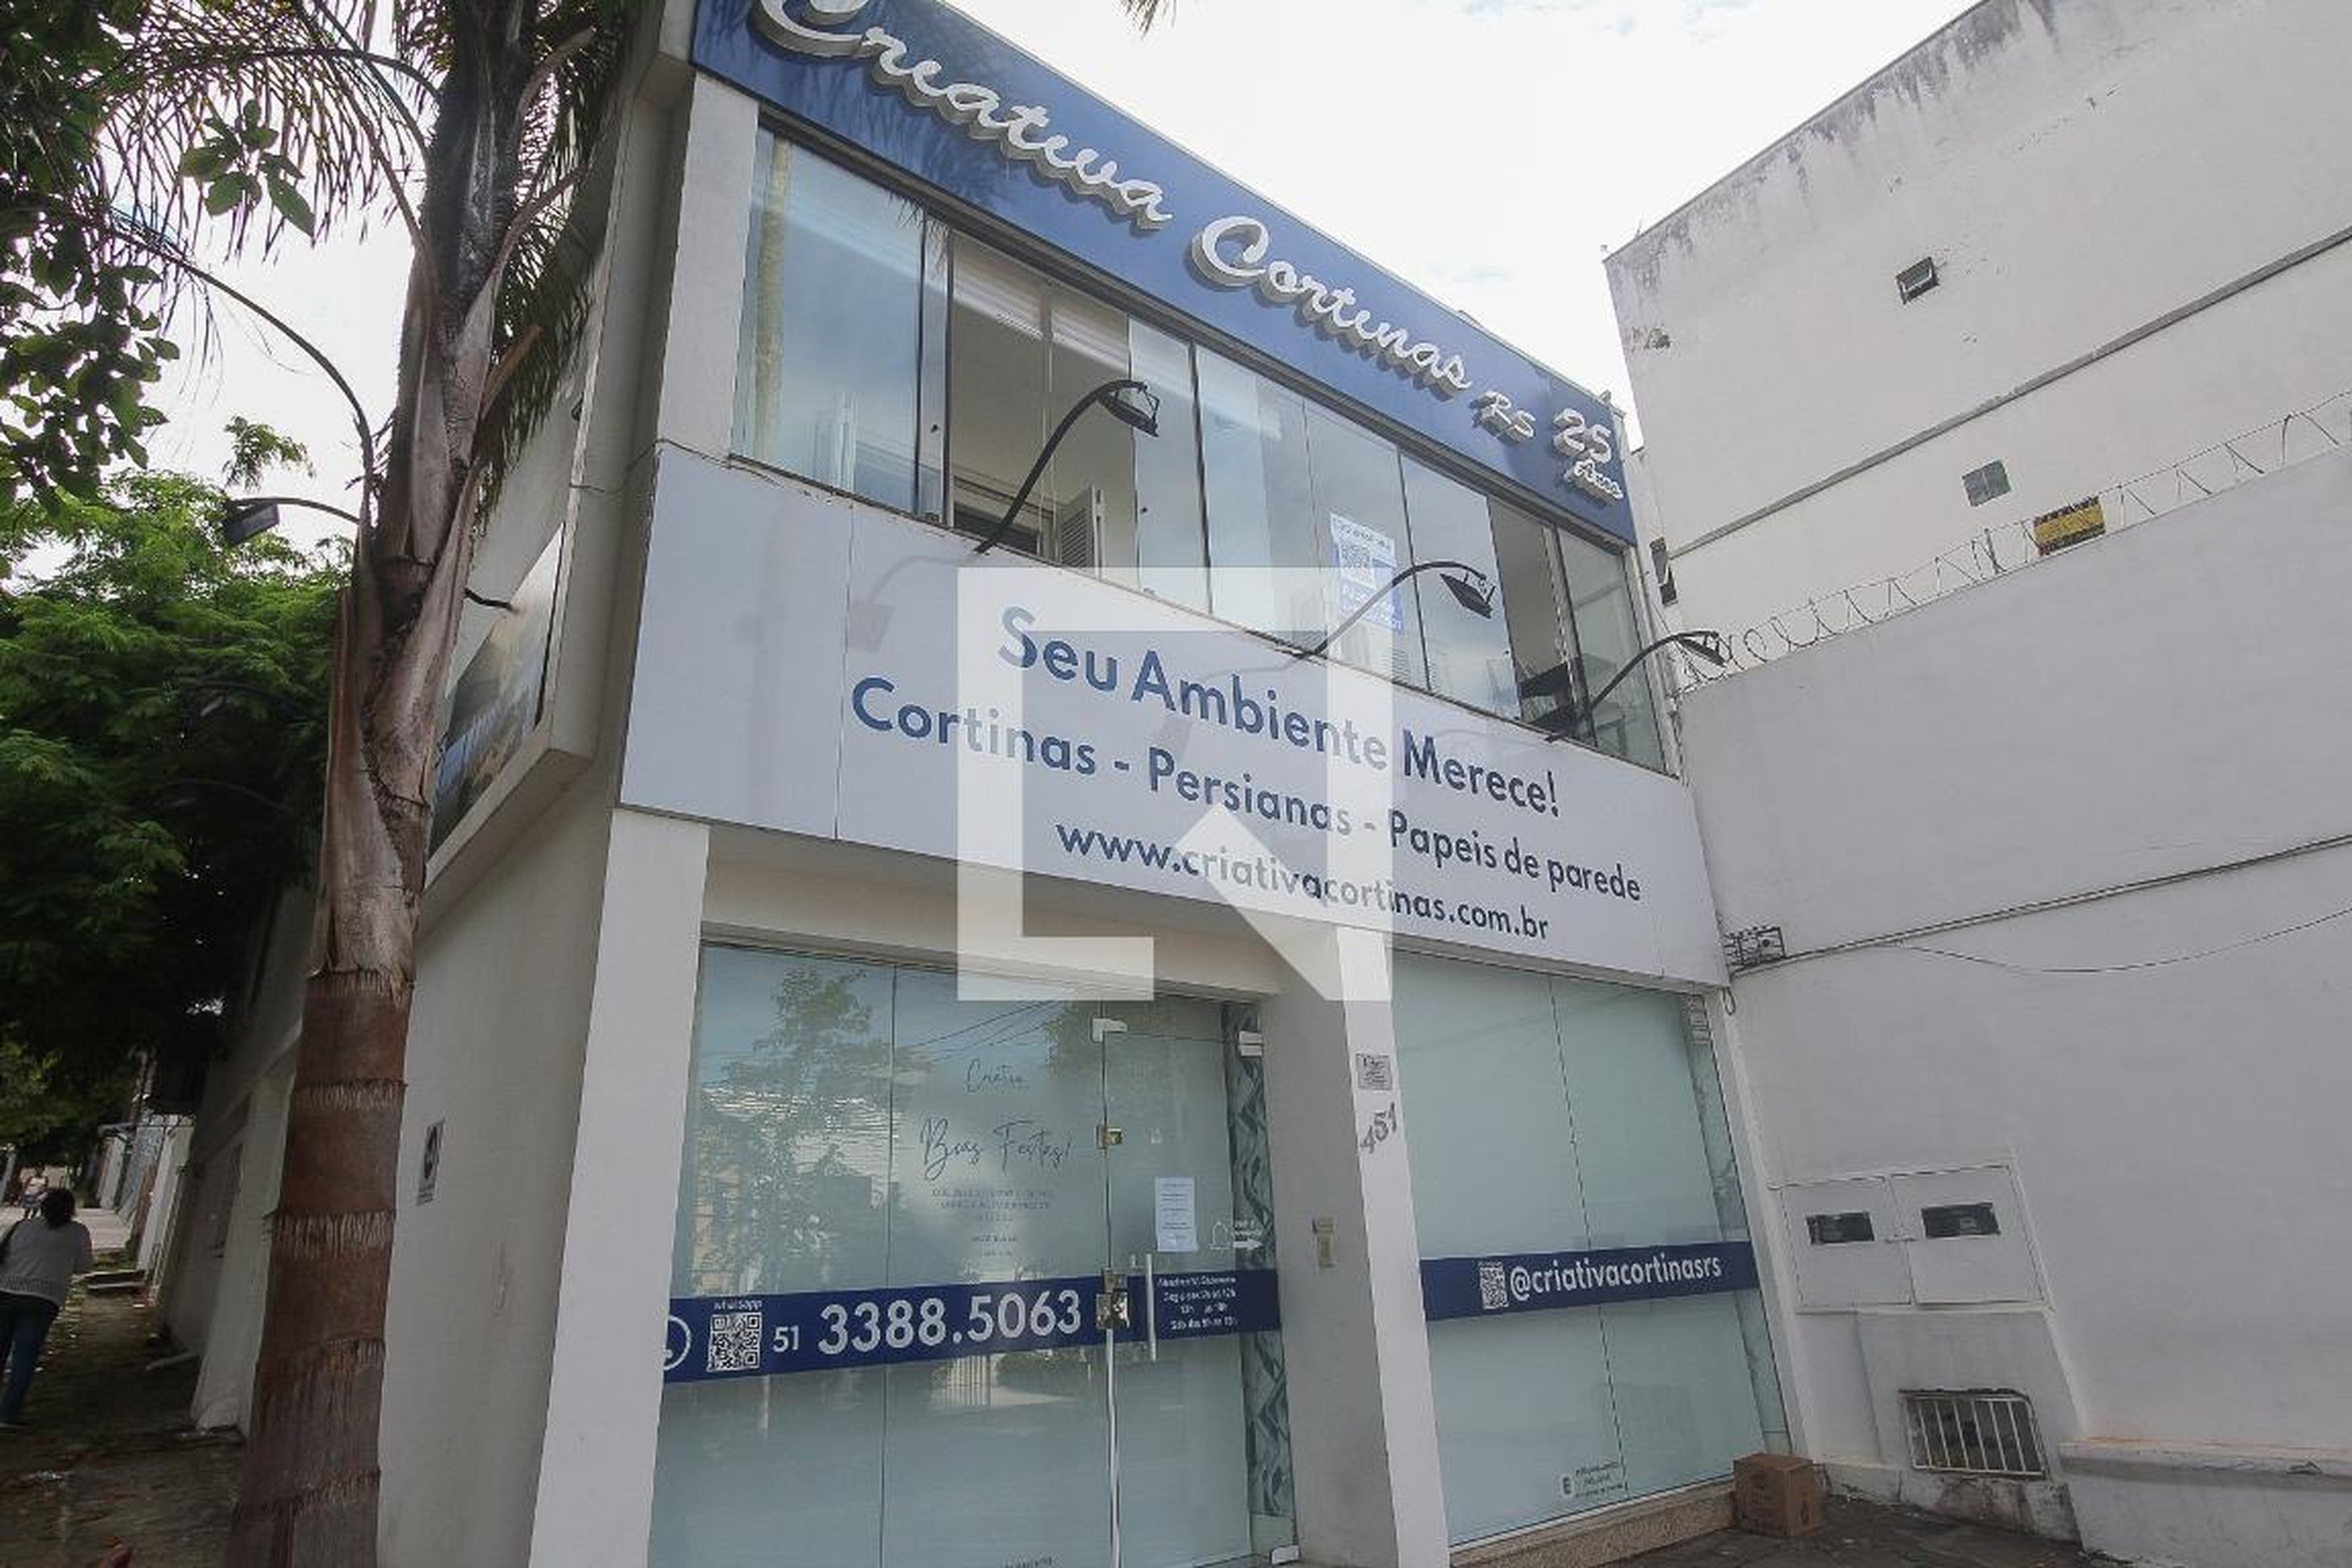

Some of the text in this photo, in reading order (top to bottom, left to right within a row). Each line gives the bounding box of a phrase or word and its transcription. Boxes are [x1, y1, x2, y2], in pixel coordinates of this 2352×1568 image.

[1199, 216, 1472, 390] Cortinas
[1553, 407, 1612, 464] 25
[997, 605, 1559, 818] Seu Ambiente Merece!
[851, 676, 1097, 776] Cortinas
[1148, 746, 1351, 837] Persianas
[1388, 808, 1498, 869] Papeis
[1504, 837, 1540, 878] de
[1547, 863, 1642, 901] parede
[1055, 823, 1550, 940] www.criativacortinas.com.br
[1360, 1101, 1397, 1154] 451
[772, 1289, 1082, 1355] 51 3388.5063
[1510, 1253, 1723, 1301] @criativacortinasrs
